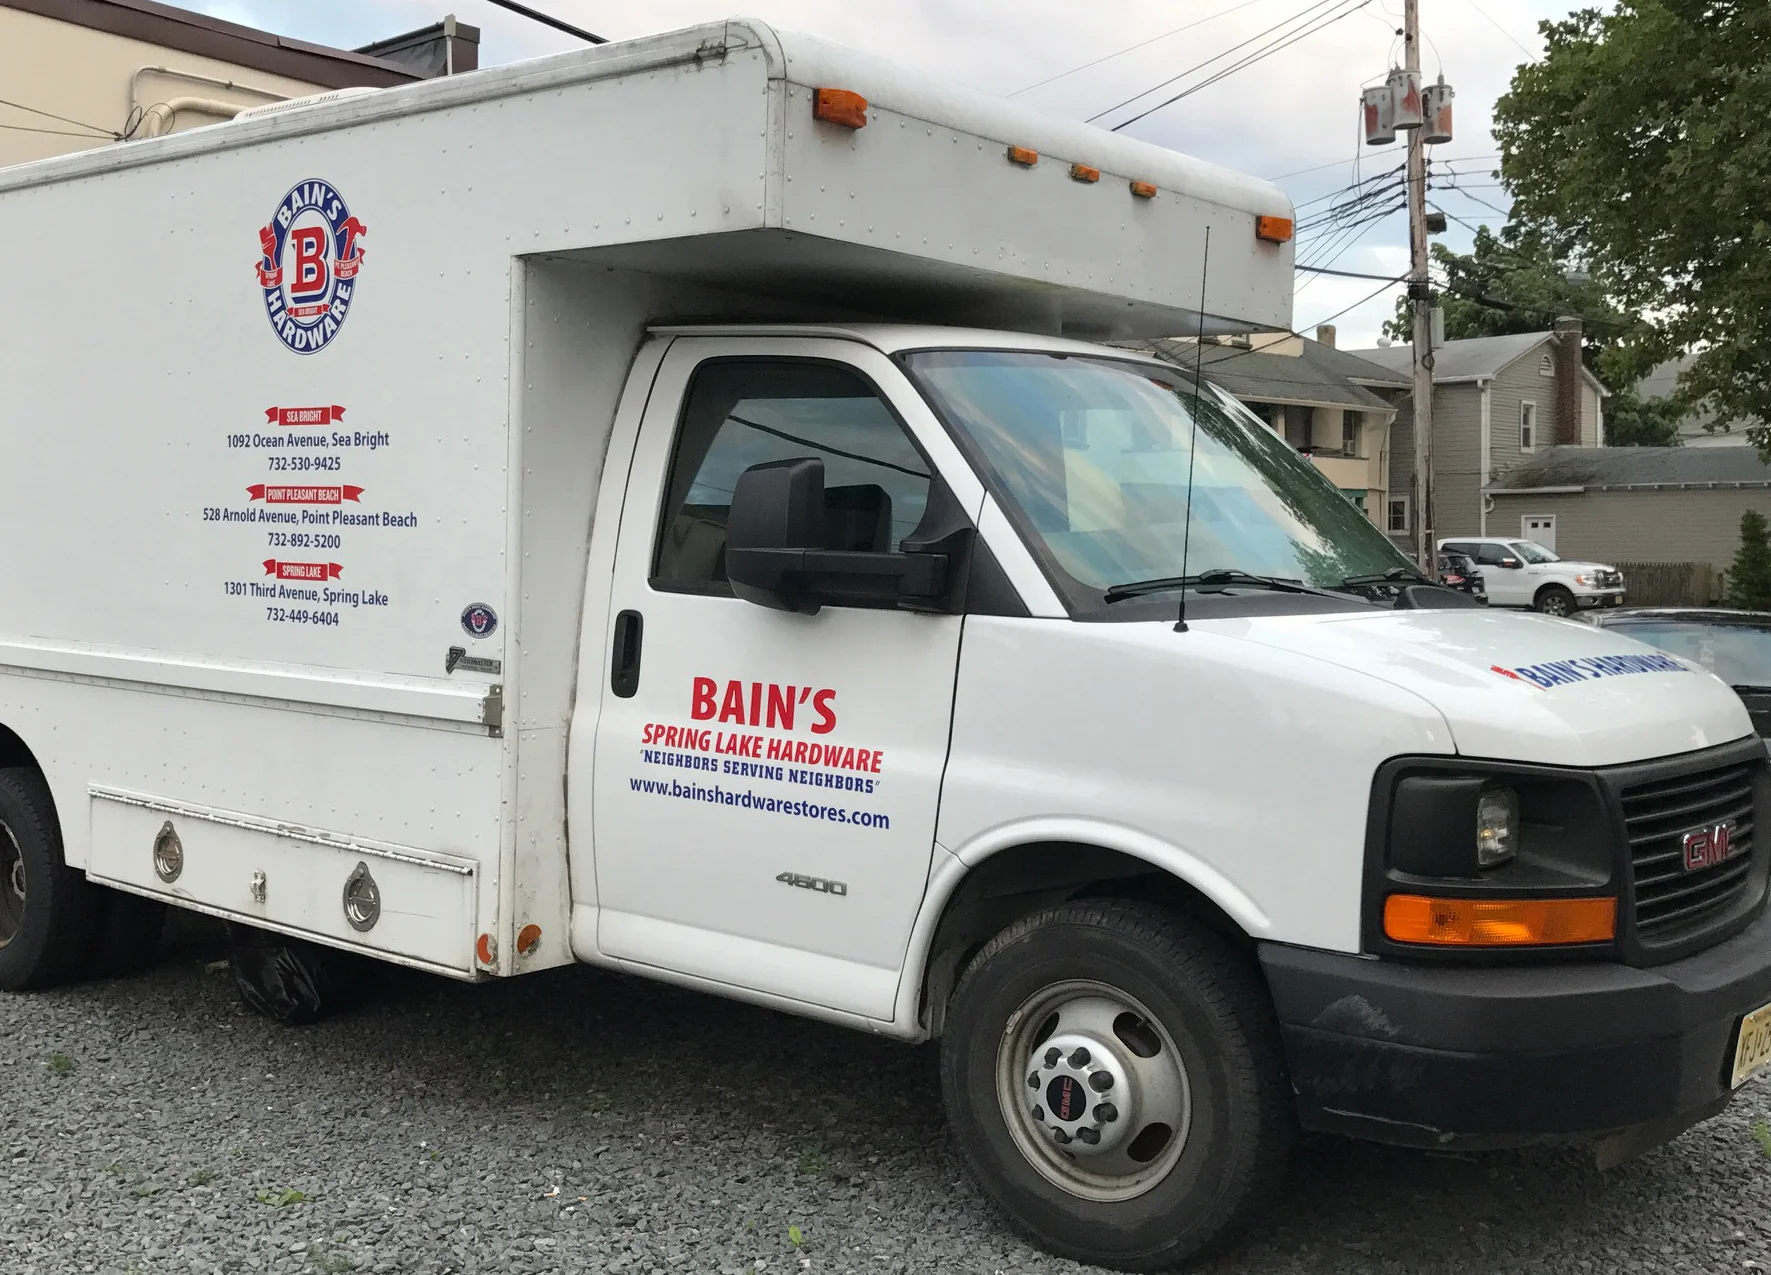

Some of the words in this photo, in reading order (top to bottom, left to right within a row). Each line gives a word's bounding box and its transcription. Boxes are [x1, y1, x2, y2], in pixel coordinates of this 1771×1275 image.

[277, 183, 342, 229] BAIN'S
[291, 226, 328, 298] B
[267, 283, 351, 350] HARDWARE
[287, 411, 298, 423] SEA
[300, 410, 322, 422] BRIGHT
[227, 434, 250, 448] 1092
[253, 433, 284, 448] Ocean
[287, 433, 329, 449] Avenue,
[332, 432, 350, 446] Sea
[354, 431, 389, 450] Bright
[268, 456, 341, 471] 732-530-9425
[268, 489, 286, 500] POINT
[287, 489, 317, 501] PLEASANT
[318, 489, 339, 501] BEACH
[203, 508, 220, 521] 528
[223, 508, 256, 522] Arnold
[258, 509, 299, 525] Avenue,
[302, 510, 330, 525] Point
[332, 510, 380, 526] Pleasant
[382, 512, 417, 527] Beach
[268, 532, 341, 548] 732-892-5200
[282, 565, 304, 577] SPRING
[306, 566, 321, 578] LAKE
[224, 581, 247, 596] 1301
[250, 582, 276, 598] Third
[278, 585, 320, 603] Avenue,
[323, 587, 359, 608] Spring
[362, 590, 389, 606] Lake
[266, 607, 340, 626] 732-449-6404
[1579, 654, 1690, 676] HARDWARE
[691, 676, 837, 734] BAIN'S
[641, 723, 712, 752] SPRING
[715, 731, 764, 759] LAKE
[767, 738, 884, 773] HARDWARE
[723, 760, 783, 781] SERVING
[629, 777, 890, 830] www.bainshardwarestores.com
[1683, 819, 1737, 871] GMC
[1060, 1077, 1073, 1120] GMC
